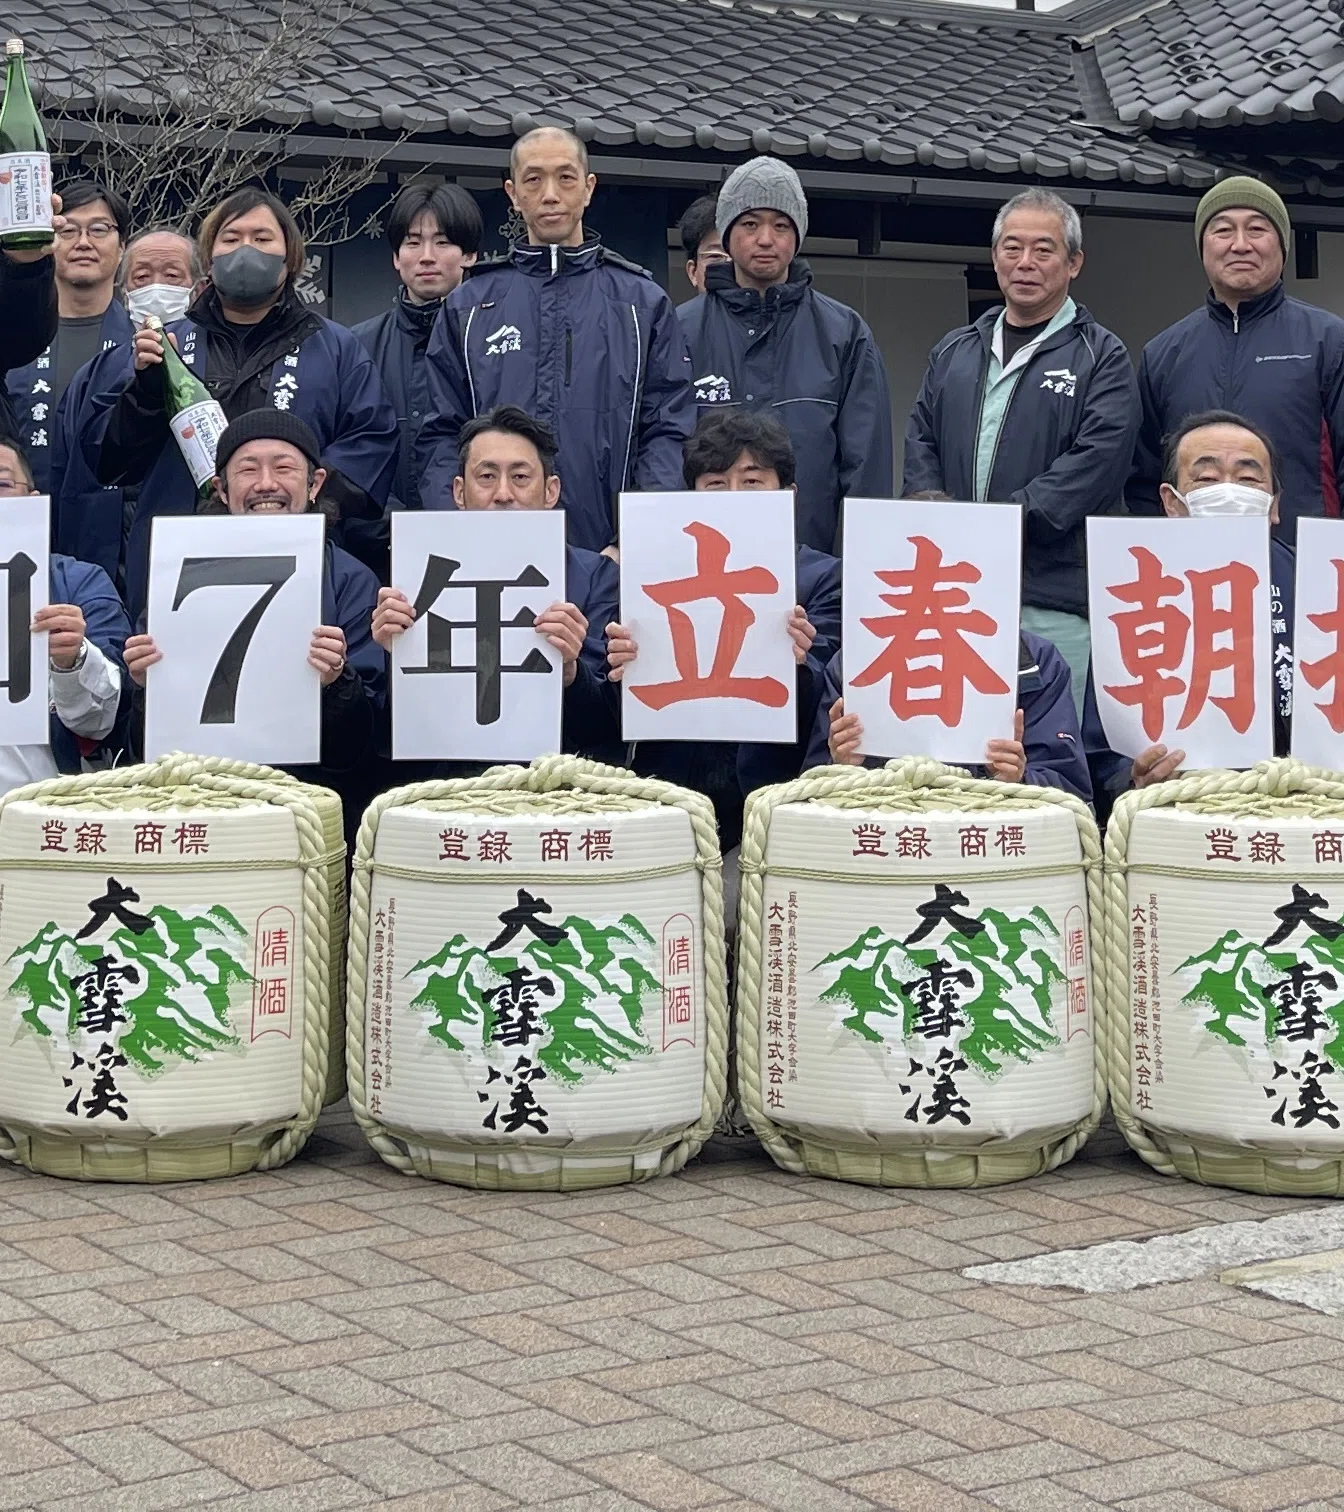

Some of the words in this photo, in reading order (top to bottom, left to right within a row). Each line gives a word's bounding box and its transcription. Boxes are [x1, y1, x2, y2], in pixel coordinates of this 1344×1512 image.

[171, 555, 296, 725] 7
[401, 553, 553, 726] 年
[628, 521, 790, 711] 立
[848, 535, 1010, 728] 春
[1102, 546, 1260, 743] 朝
[40, 819, 108, 855] 登録
[133, 821, 211, 855] 商標
[438, 827, 513, 863] 登録
[539, 828, 616, 863] 商標
[851, 823, 932, 859] 登録
[958, 824, 1027, 858] 商標
[1205, 827, 1286, 864] 登録
[258, 928, 290, 1017] 清酒
[668, 935, 691, 1026] 清酒
[766, 901, 786, 1109] 大雪渓酒造株式会社
[1069, 928, 1086, 1014] 清酒
